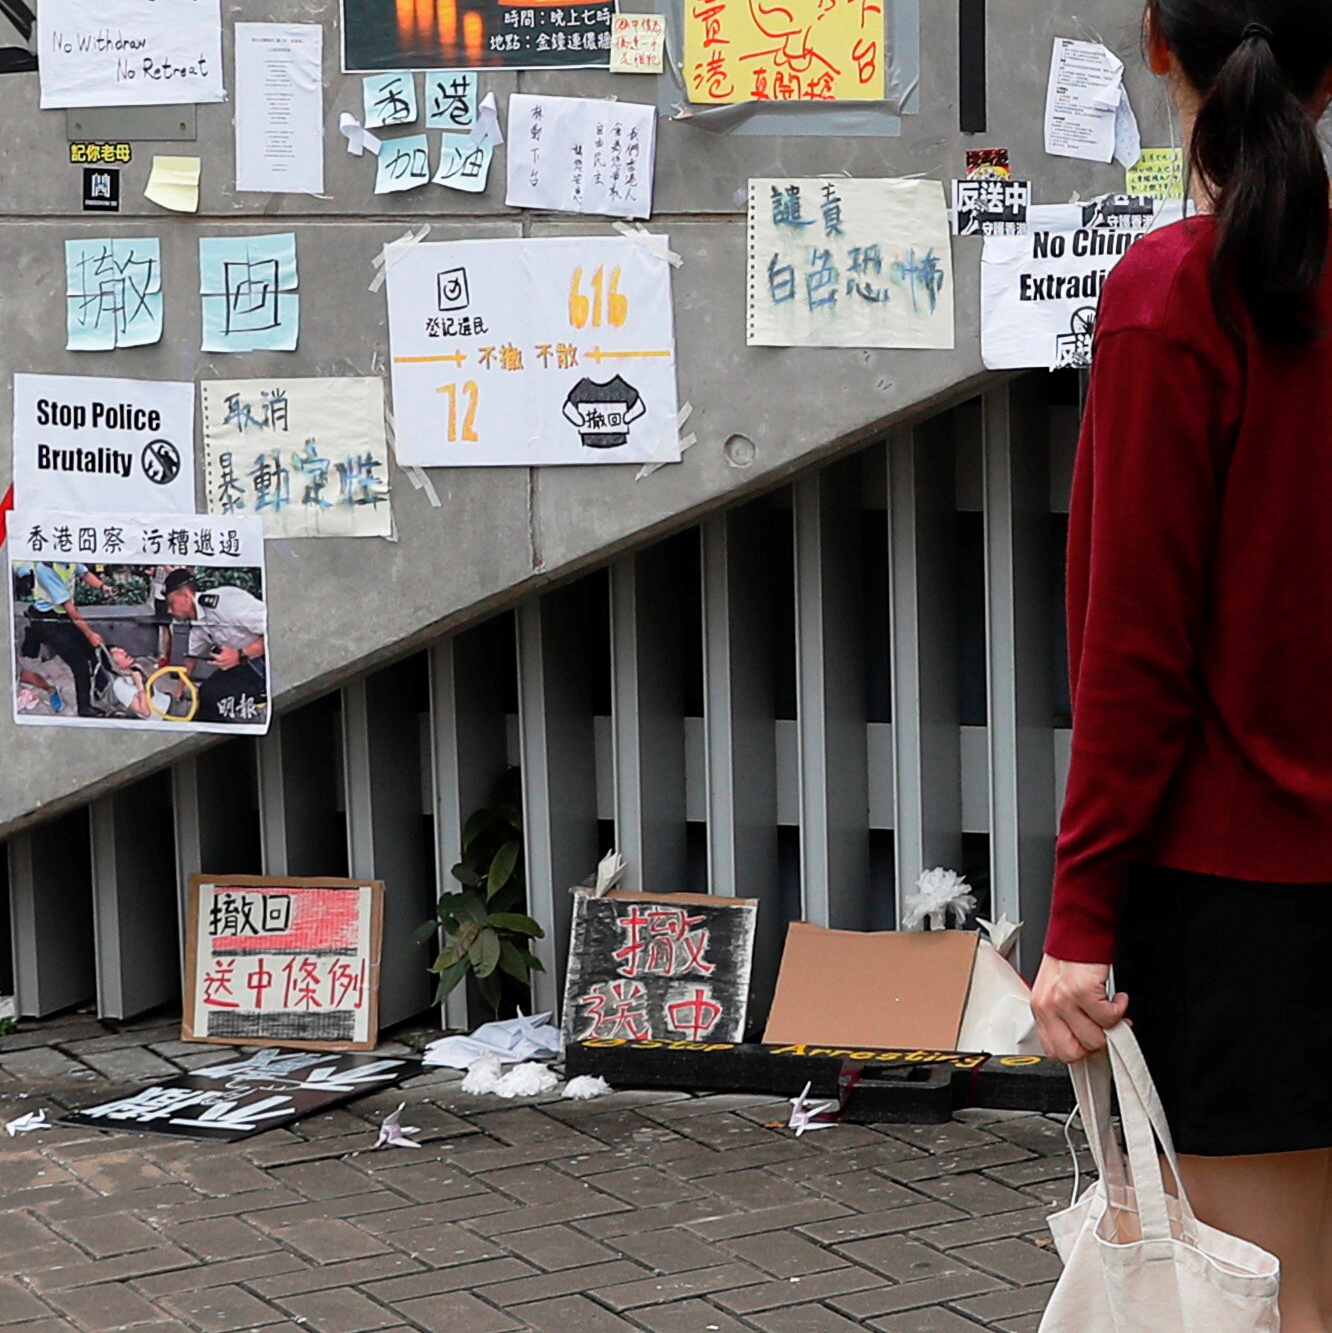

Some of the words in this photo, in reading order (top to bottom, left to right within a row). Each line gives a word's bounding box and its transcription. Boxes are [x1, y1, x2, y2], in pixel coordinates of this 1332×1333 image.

[53, 32, 72, 54] No
[77, 29, 146, 51] Withdraw
[116, 57, 136, 82] No
[142, 57, 209, 80] Retreat
[373, 76, 476, 125] 香港
[70, 144, 130, 162] 記你老母
[956, 182, 1028, 214] 反送中
[1033, 231, 1065, 259] No
[568, 263, 629, 329] 616
[766, 244, 945, 315] 白色恐怖
[535, 344, 579, 369] 不散
[36, 399, 85, 430] Stop
[91, 402, 161, 431] Police
[222, 386, 289, 434] 取消
[585, 410, 623, 429] 撤回
[37, 443, 132, 479] Brutality
[217, 694, 258, 719] 明報
[209, 894, 291, 936] 撤回
[612, 907, 715, 977] 撤
[203, 957, 366, 1010] 送中條例
[575, 982, 723, 1041] 送中
